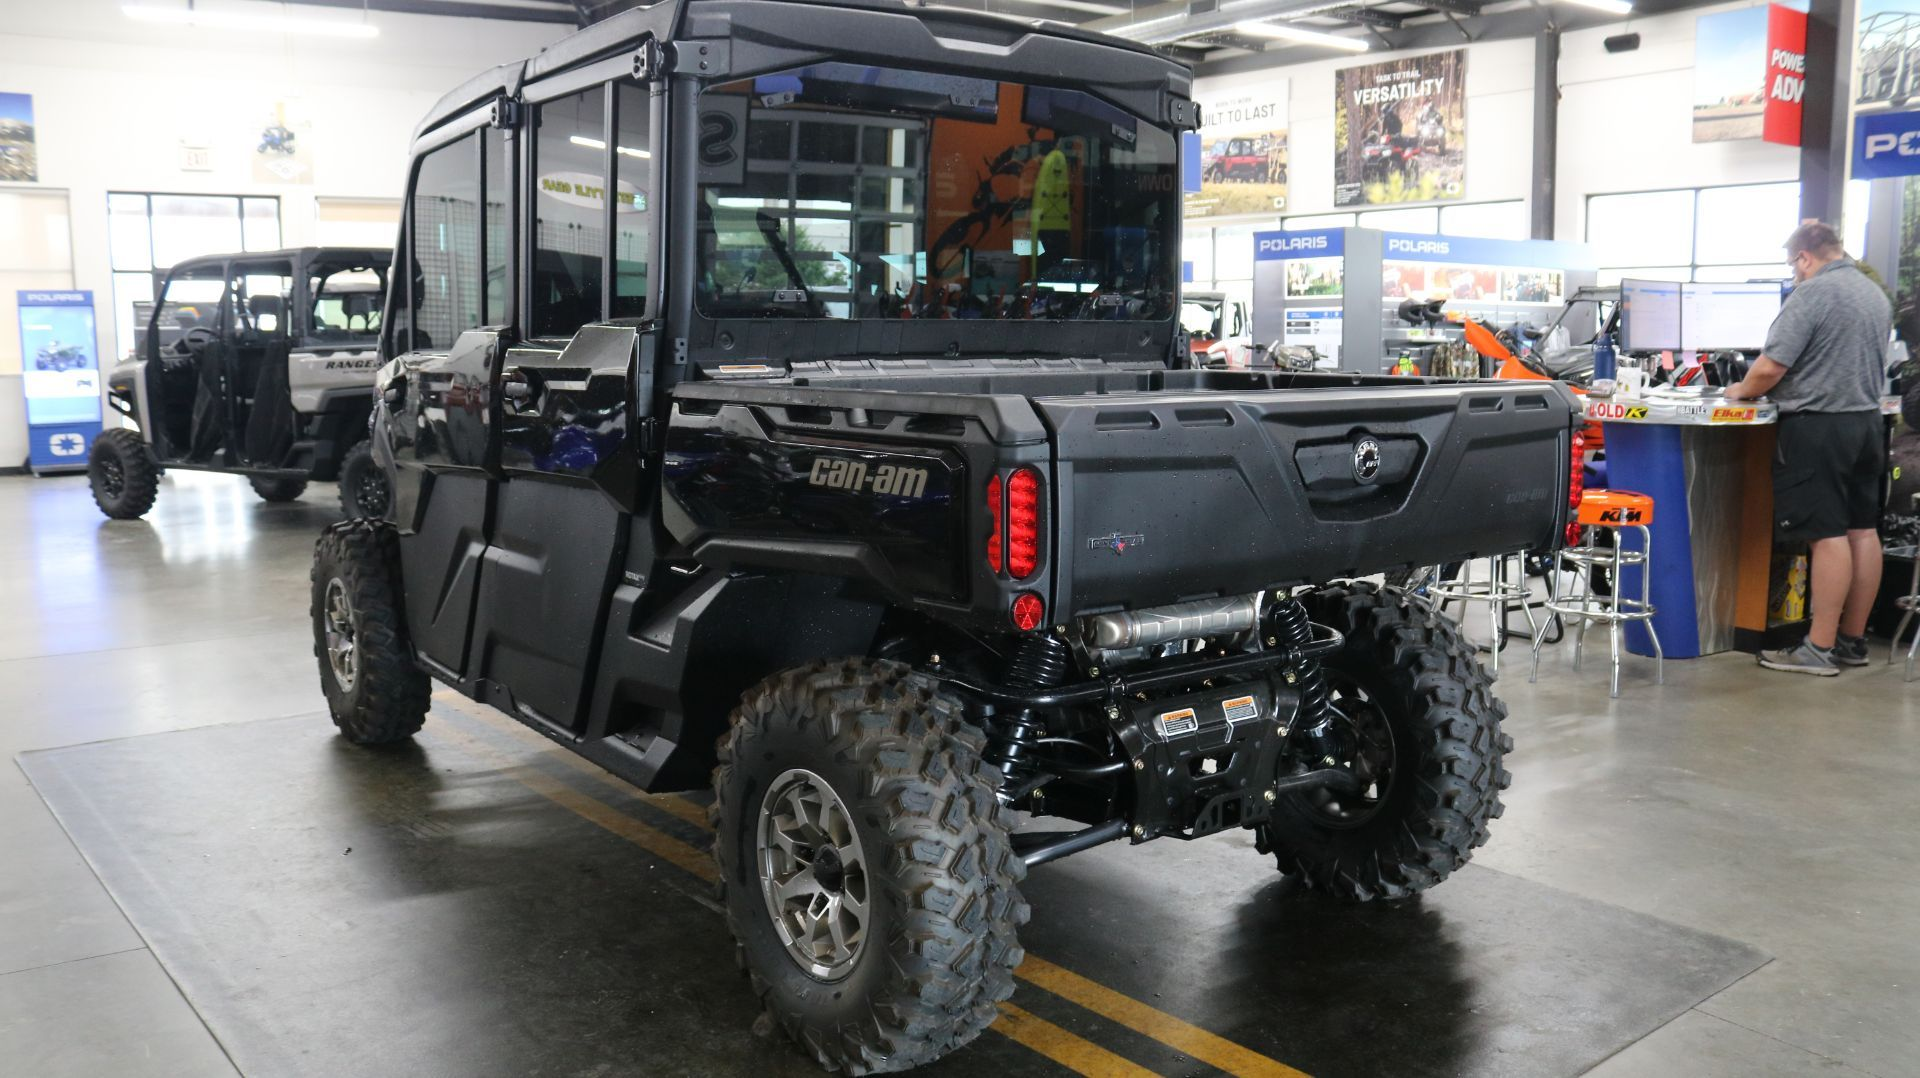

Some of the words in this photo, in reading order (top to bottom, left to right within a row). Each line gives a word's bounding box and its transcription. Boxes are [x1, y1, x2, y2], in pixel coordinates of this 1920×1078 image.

[1376, 72, 1392, 83] TASK
[1393, 72, 1401, 81] TO
[1353, 77, 1445, 106] VERSATILITY
[1201, 111, 1224, 127] UILT
[1228, 109, 1242, 123] TO
[1245, 103, 1276, 121] LAST
[1260, 236, 1328, 252] POLARIS
[1389, 238, 1450, 254] POLARIS
[26, 293, 85, 301] POLARIS
[809, 458, 928, 498] can-am
[1600, 508, 1642, 522] KTM
